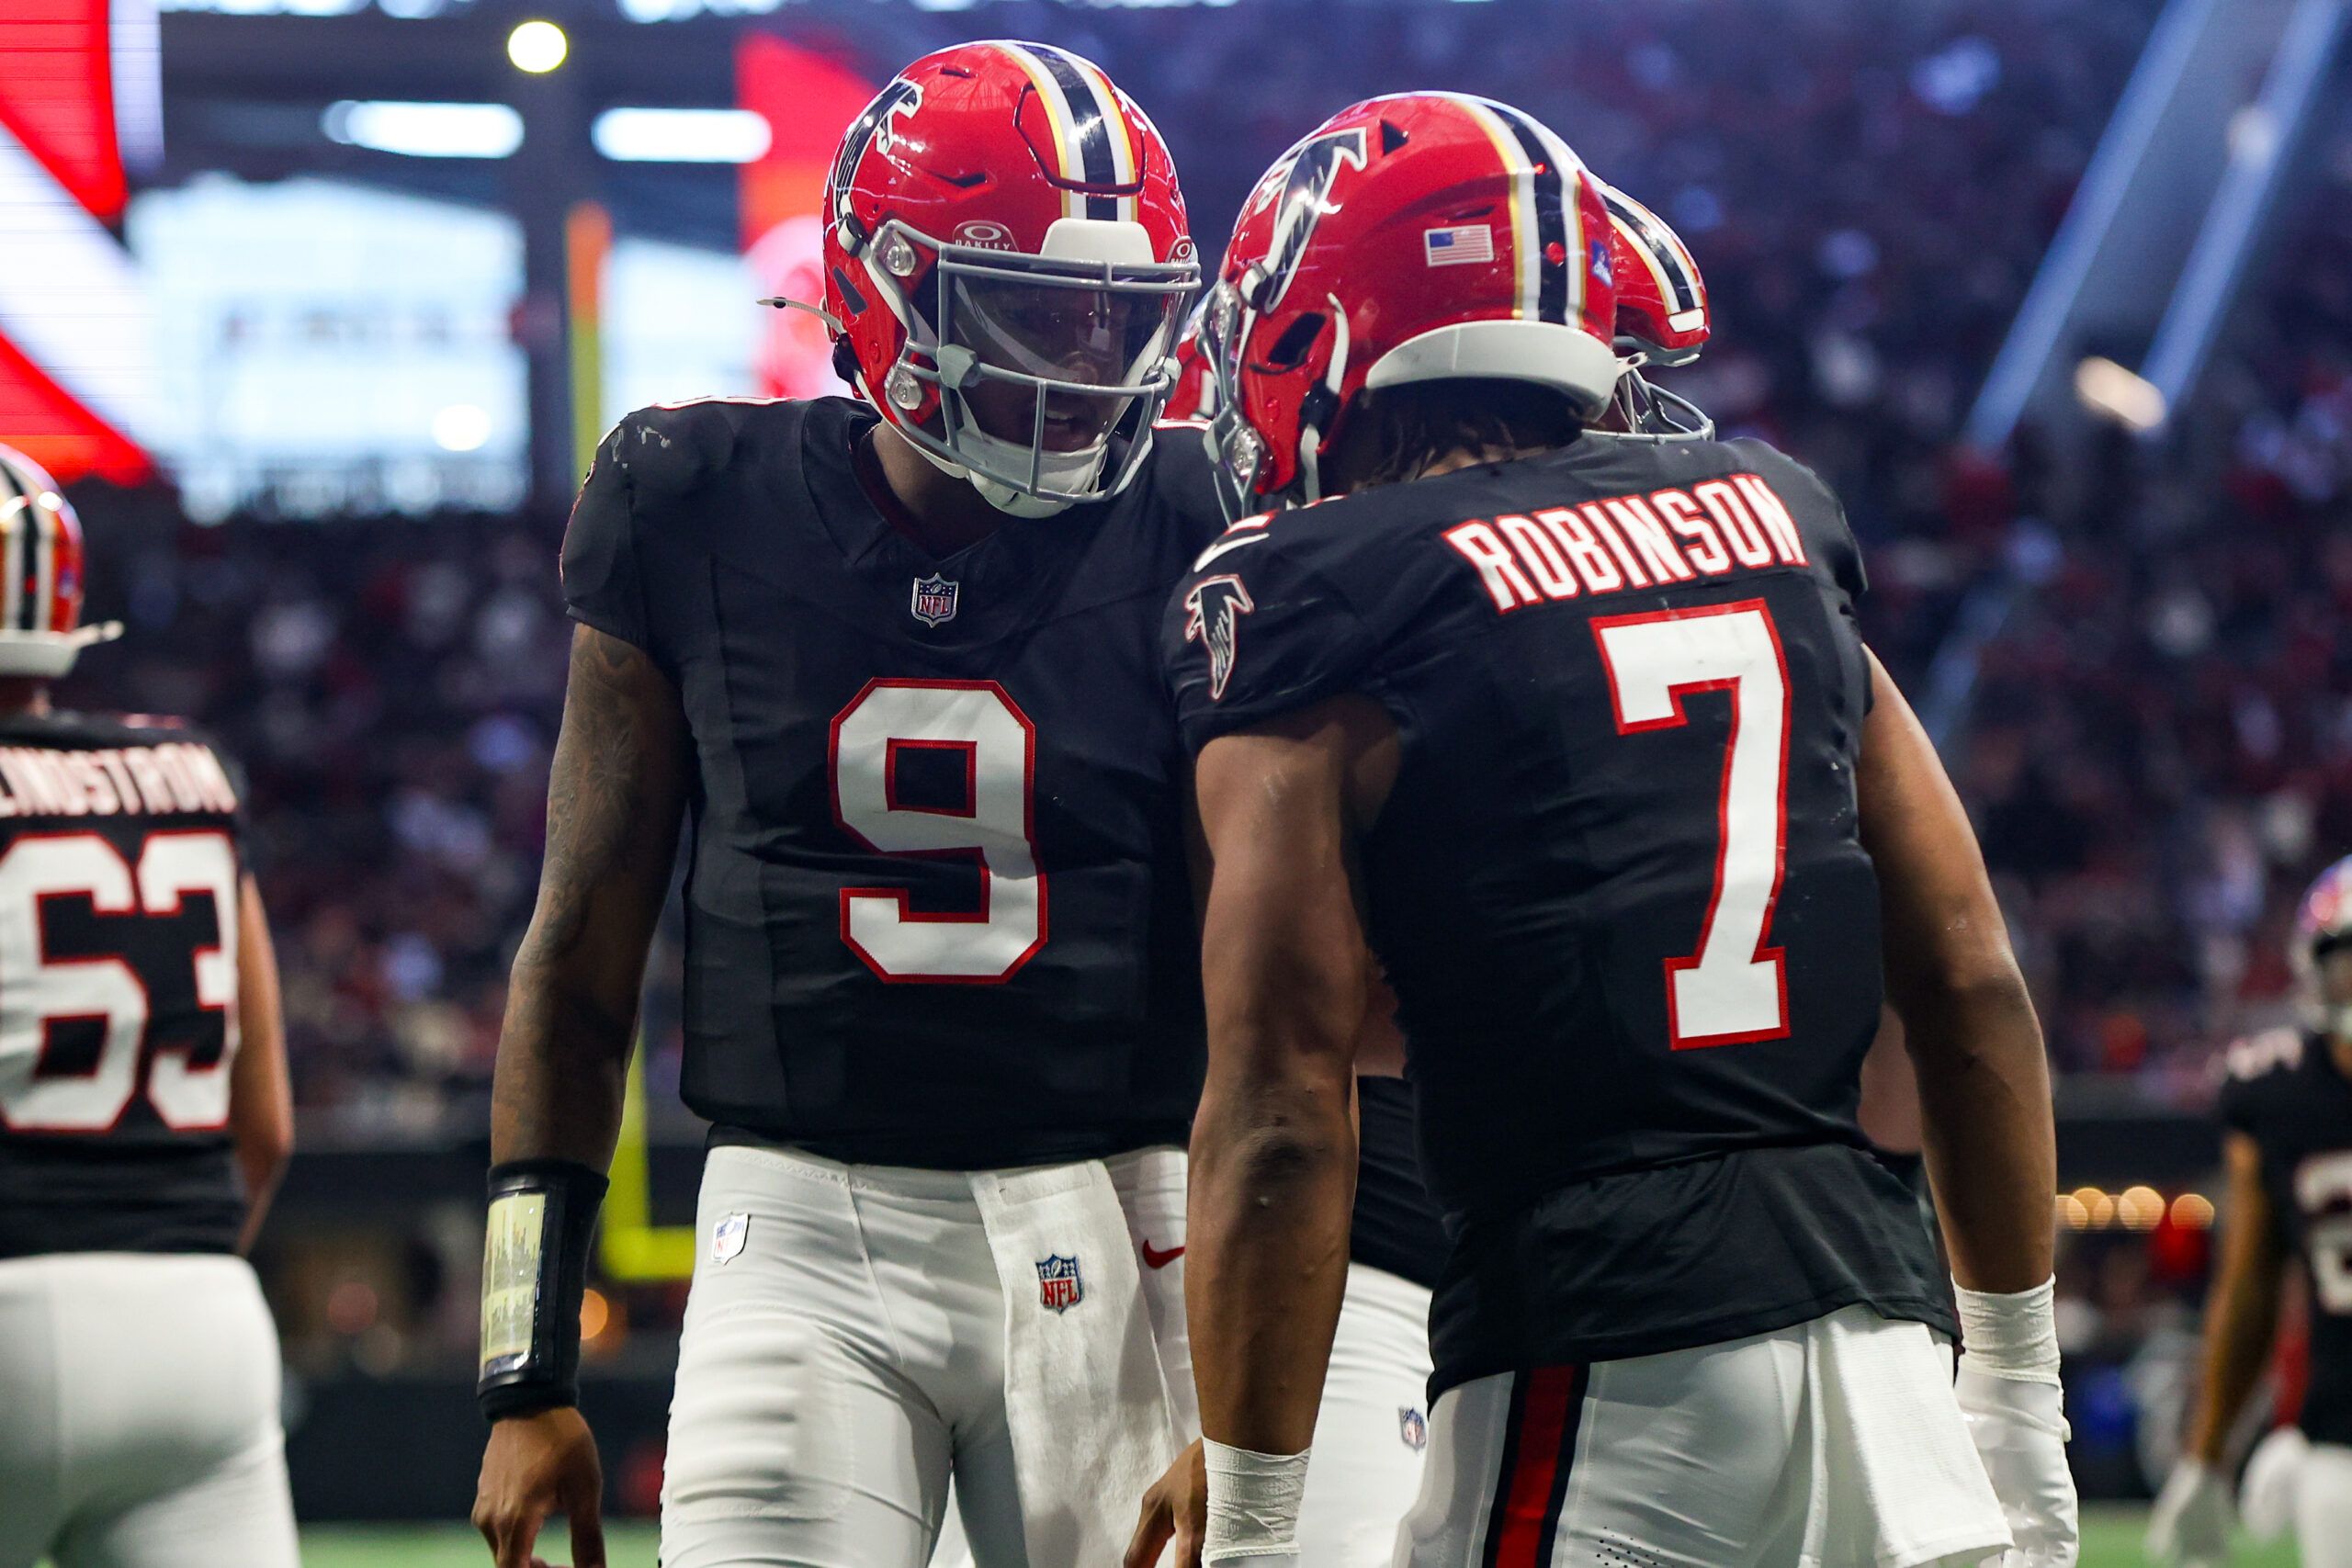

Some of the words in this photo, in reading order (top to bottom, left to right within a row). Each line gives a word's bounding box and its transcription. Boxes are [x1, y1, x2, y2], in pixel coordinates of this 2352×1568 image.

[919, 595, 950, 615] NFL
[1441, 473, 1810, 615] ROBINSON
[829, 677, 1047, 984] 9
[1589, 597, 1792, 1051] 7
[0, 828, 241, 1134] 63
[1042, 1278, 1078, 1308] NFL
